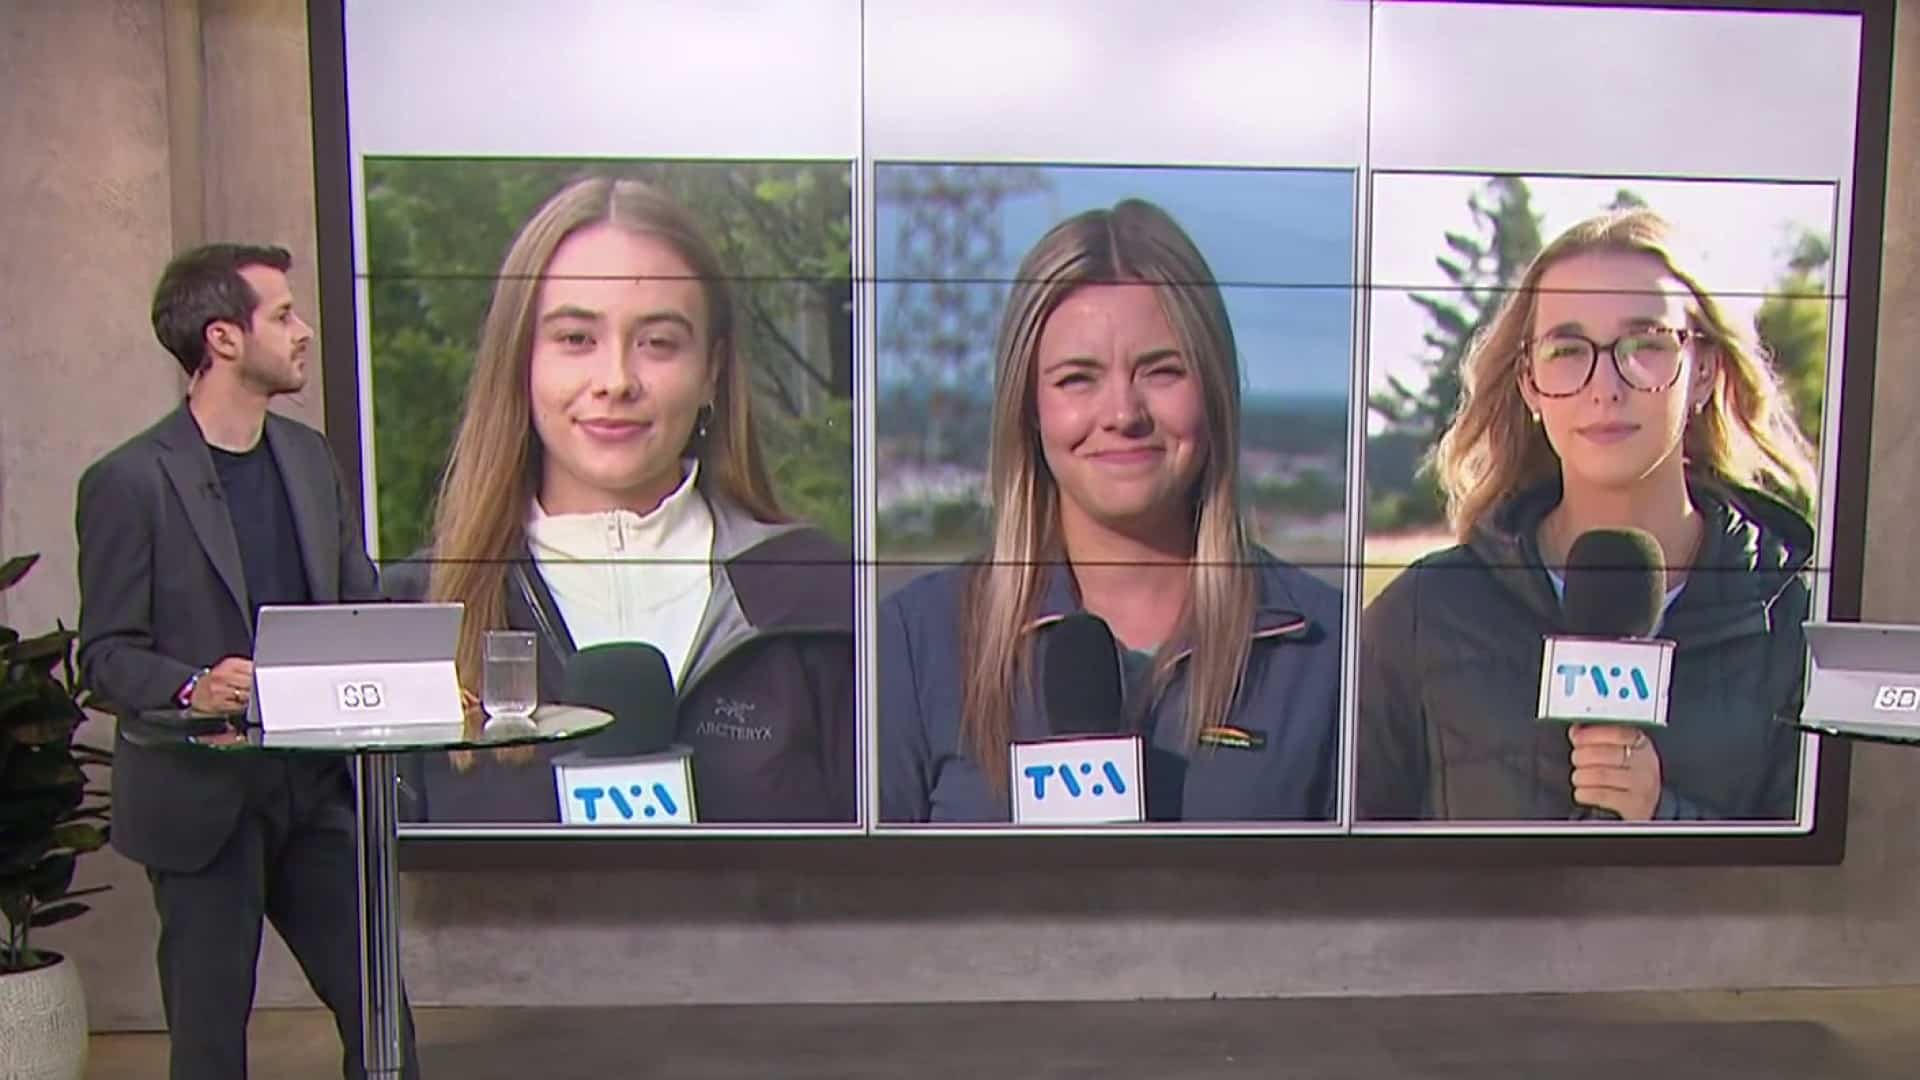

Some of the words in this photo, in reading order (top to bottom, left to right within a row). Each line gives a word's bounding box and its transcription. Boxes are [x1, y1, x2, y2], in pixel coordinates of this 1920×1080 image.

[1557, 665, 1649, 700] TVA
[1024, 761, 1126, 800] TVA
[573, 783, 678, 821] TVA
